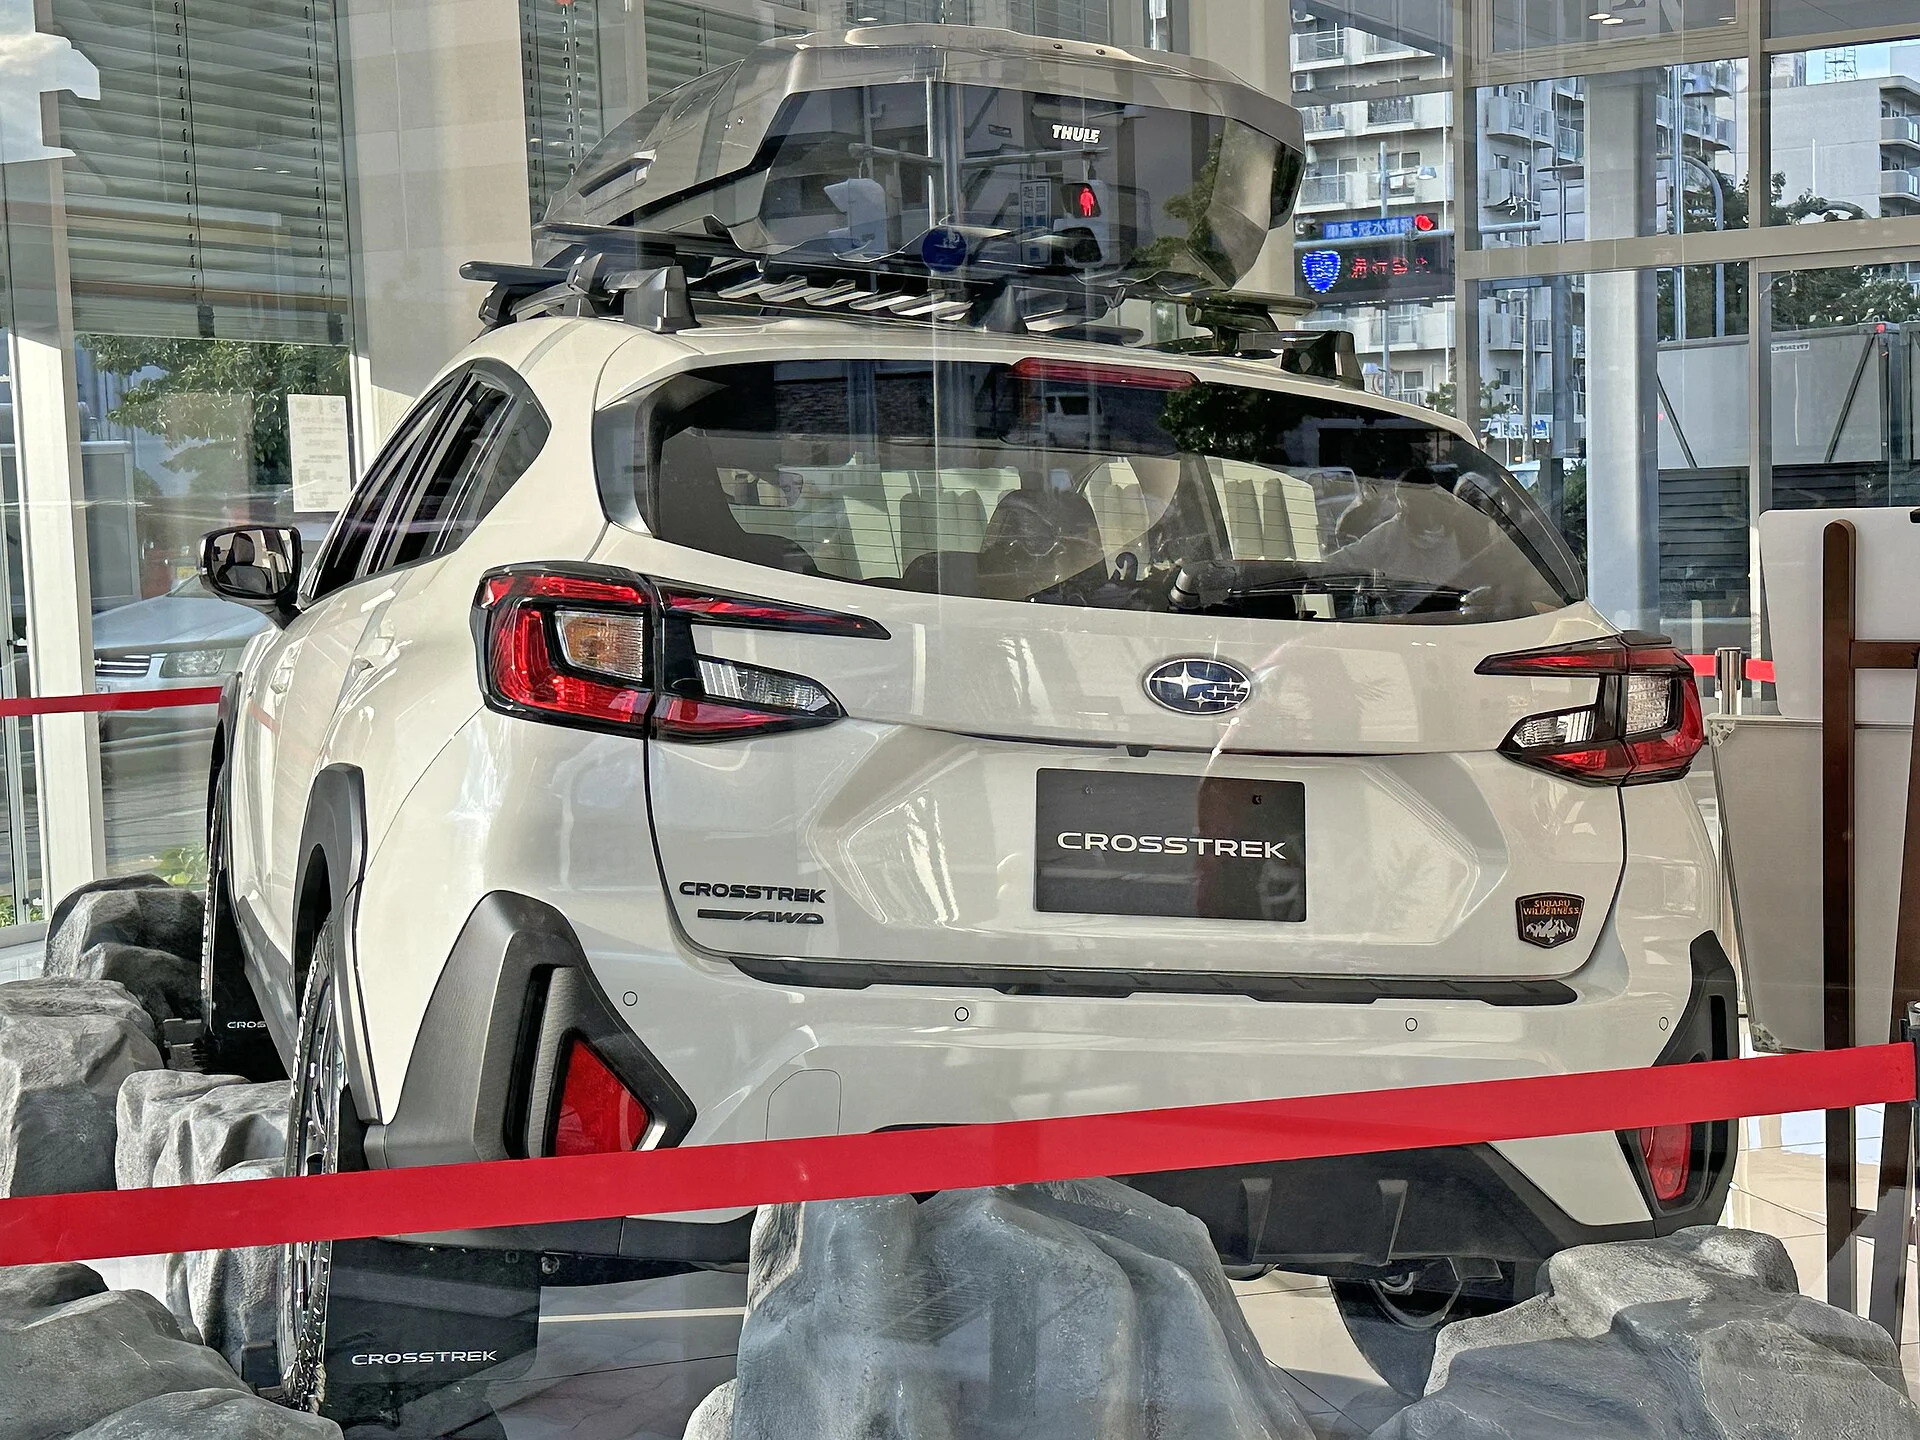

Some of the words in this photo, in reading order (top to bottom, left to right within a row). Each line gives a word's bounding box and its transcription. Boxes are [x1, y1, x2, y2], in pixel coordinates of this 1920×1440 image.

[1052, 124, 1101, 144] THULE
[1057, 831, 1286, 860] CROSSTREK
[679, 881, 827, 903] CROSSTREK
[1523, 907, 1580, 916] WILDERNESS
[1534, 899, 1571, 908] SUBARU
[743, 910, 825, 925] AWD
[351, 1350, 498, 1366] CROSSTREK
